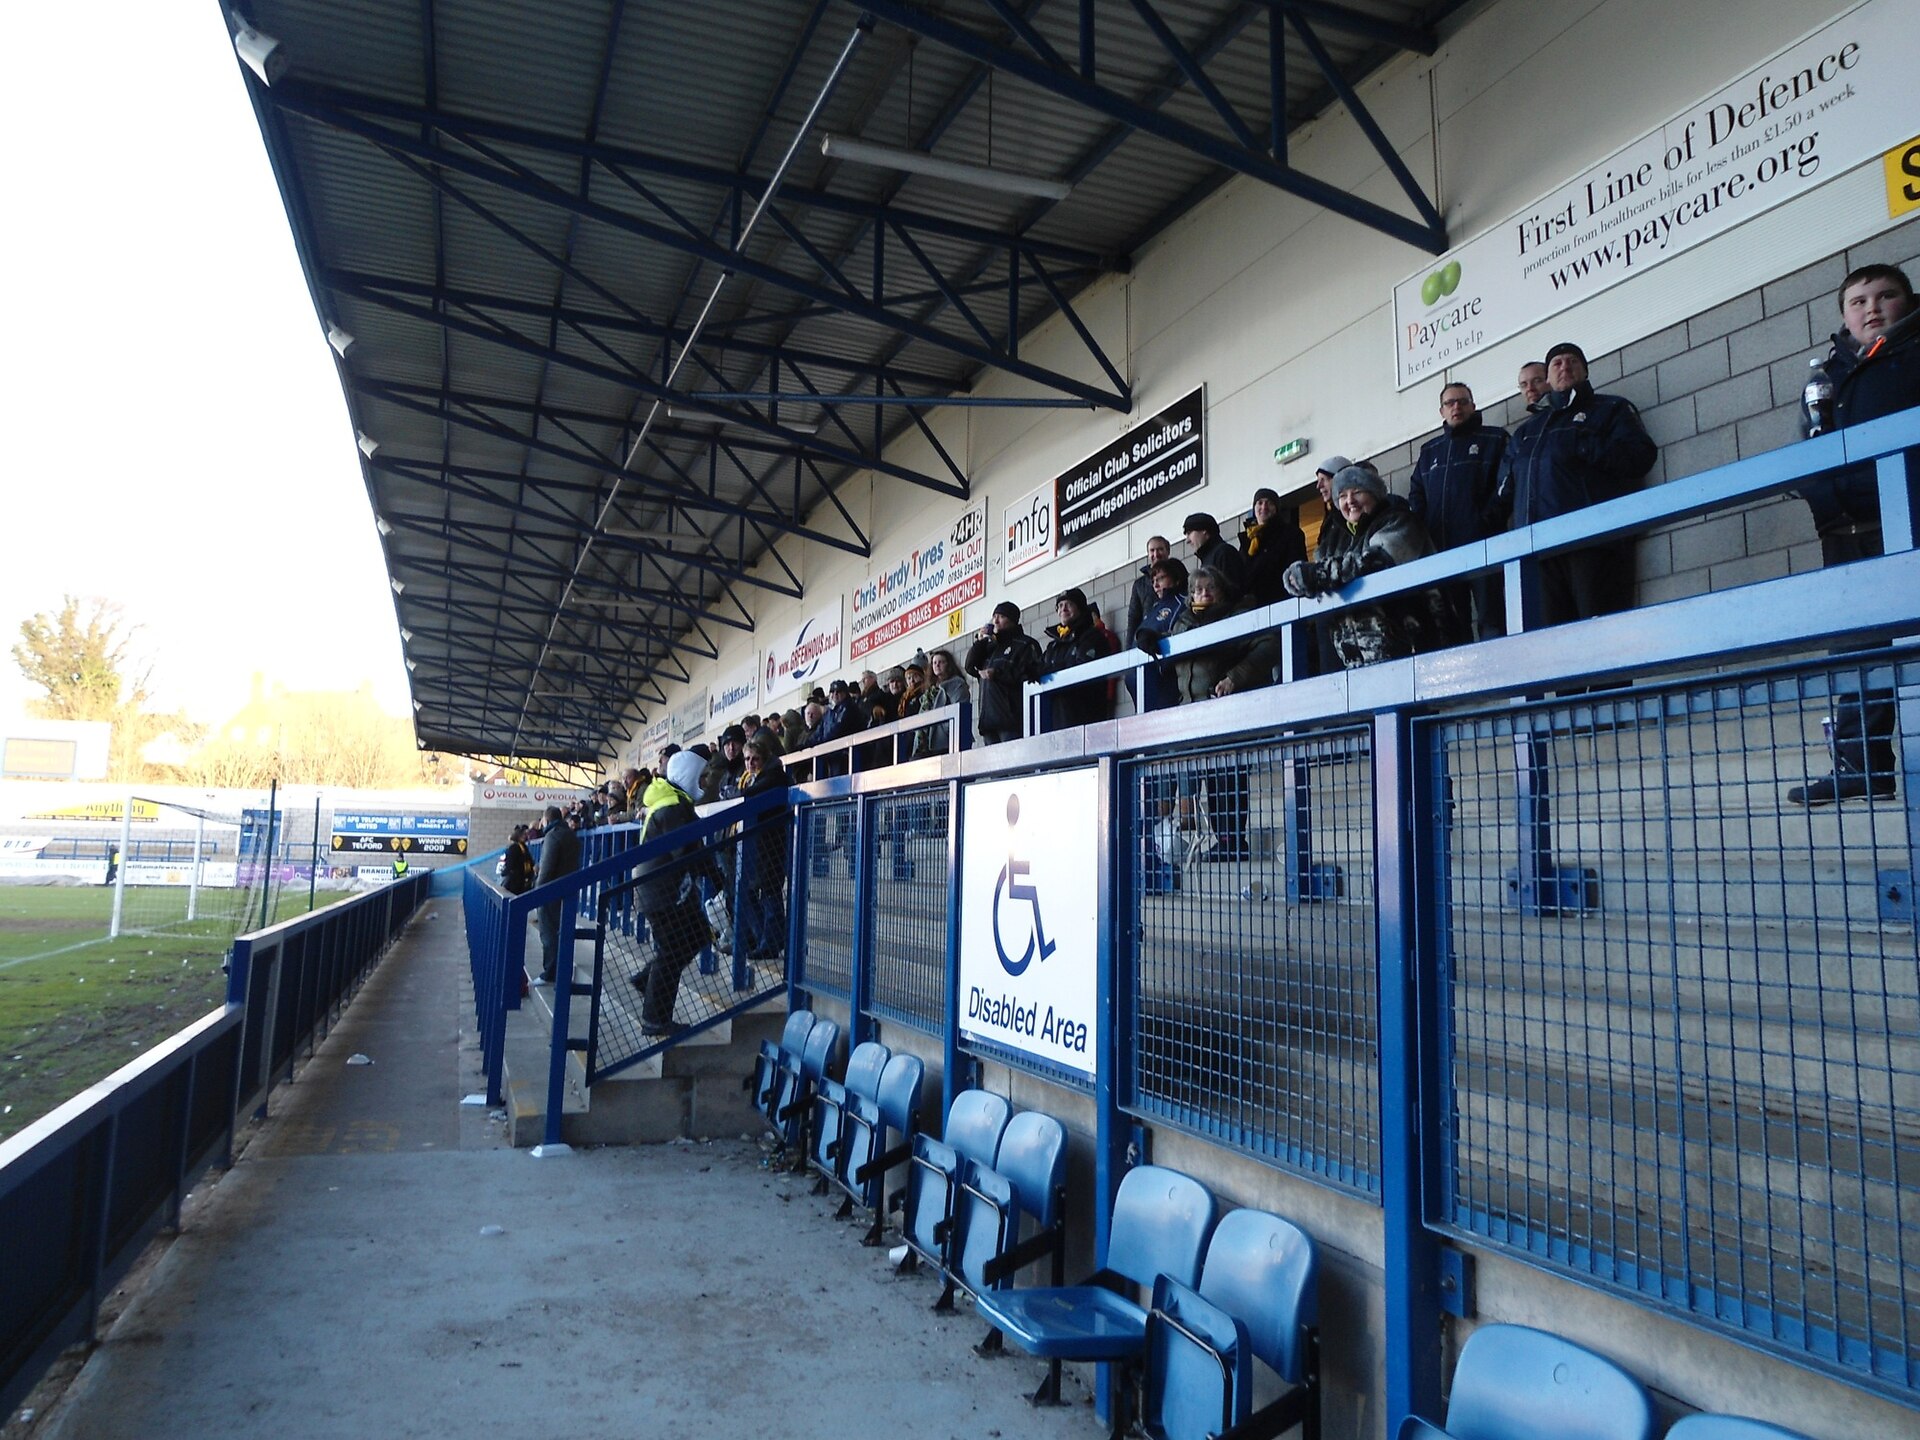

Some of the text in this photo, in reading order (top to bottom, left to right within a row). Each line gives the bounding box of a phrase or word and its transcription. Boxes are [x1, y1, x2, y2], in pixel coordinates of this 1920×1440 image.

[1516, 42, 1860, 257] First Line of Defence
[1523, 83, 1856, 279] protection from healthcare bills for less than £1.50 a week
[1549, 131, 1820, 291] www.paycare.org
[1408, 297, 1482, 351] Paycare
[1408, 330, 1483, 375] here to help
[1066, 415, 1192, 502] Official Club Solicitors
[1014, 496, 1049, 550] mfg
[1062, 452, 1197, 537] www.mfgsolicitors.com
[854, 541, 944, 613] Chris Hardy Tyres
[949, 538, 982, 568] CALL OUT
[1008, 544, 1039, 567] solicitors
[852, 569, 944, 635] HORTONWOOD 01952 270009
[874, 619, 902, 646] EXHAUSTS
[908, 603, 932, 629] BRAKES
[939, 579, 976, 613] SERVICING
[86, 803, 144, 815] Anythng
[361, 816, 388, 824] TELFORD
[496, 791, 528, 799] VEOLIA
[352, 842, 383, 850] TELFORD
[968, 985, 1088, 1053] Disabled Area
